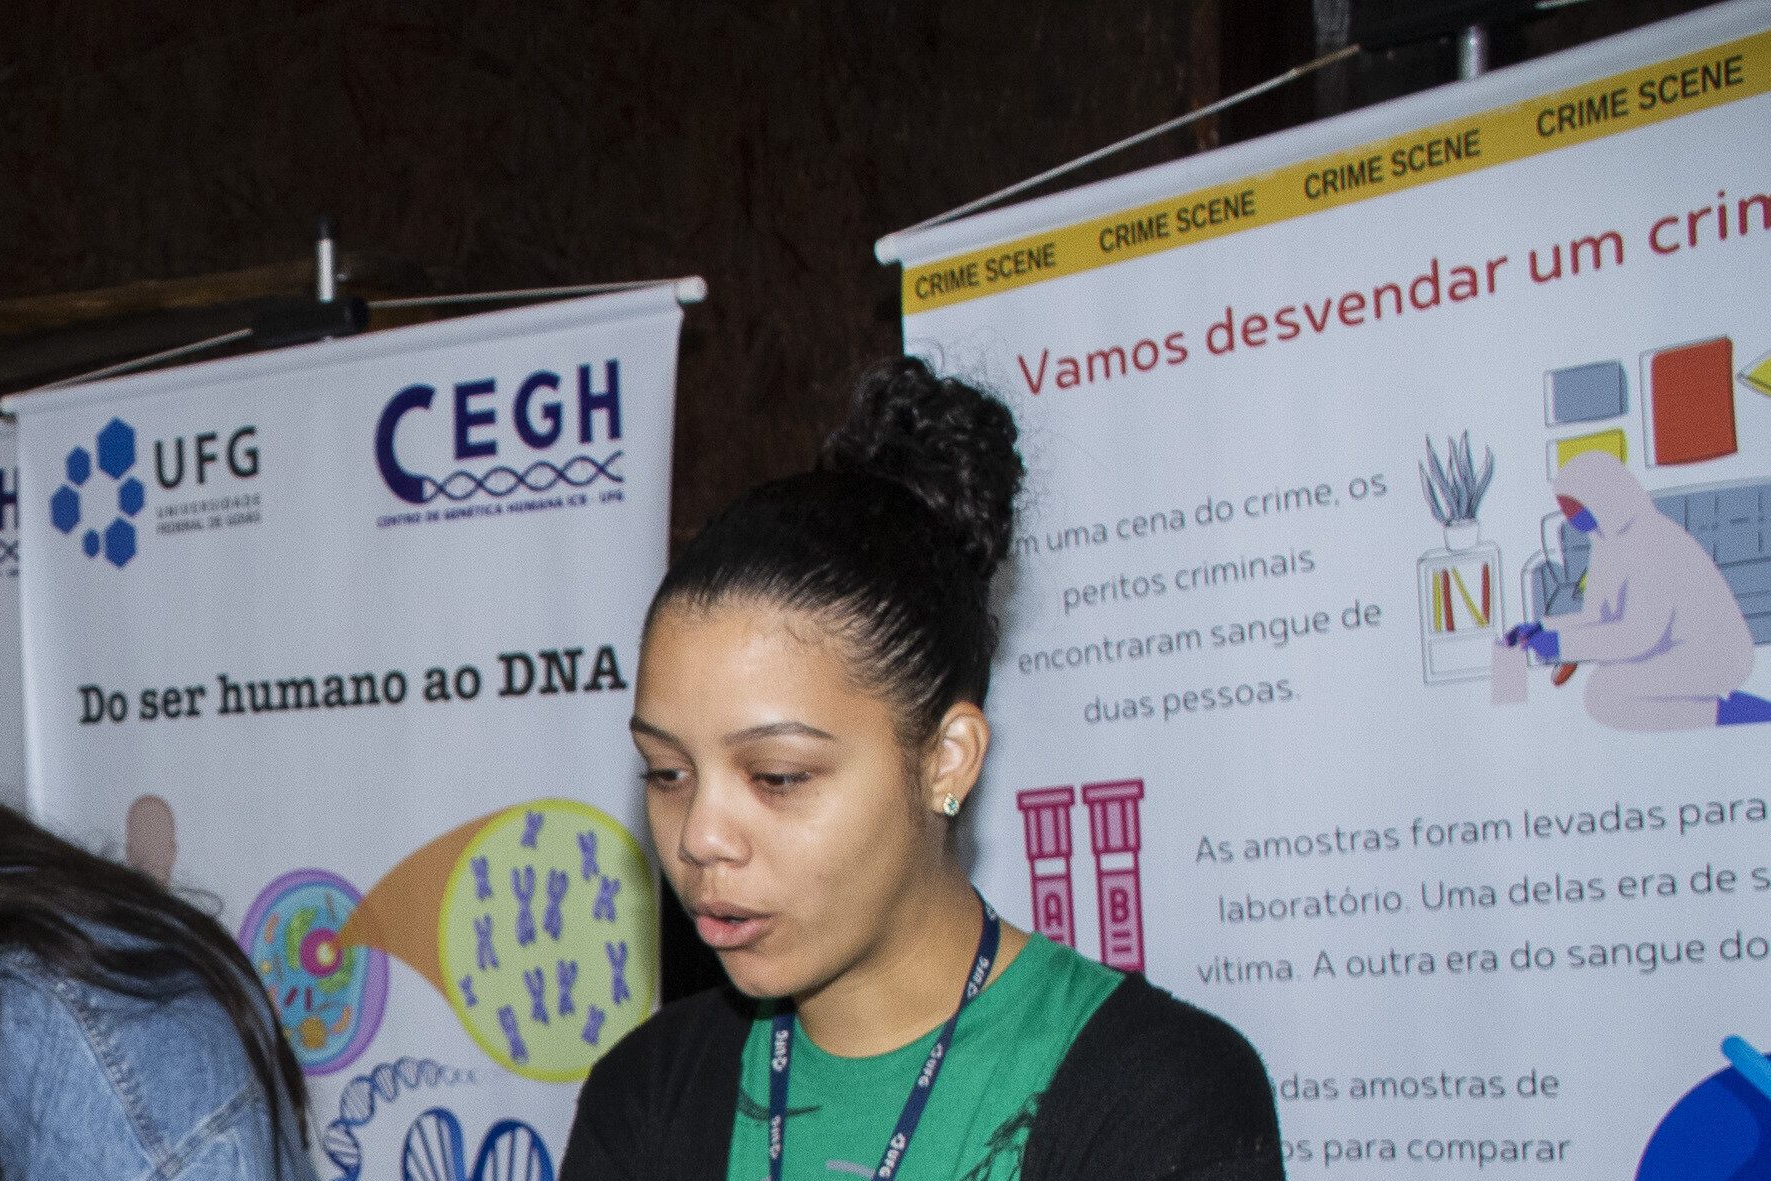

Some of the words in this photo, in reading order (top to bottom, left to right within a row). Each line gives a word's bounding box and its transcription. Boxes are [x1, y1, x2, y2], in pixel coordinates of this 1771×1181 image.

[915, 265, 980, 301] CRIME
[985, 242, 1056, 283] SCENE
[1099, 213, 1170, 253] CRIME
[1177, 190, 1256, 233] SCENE
[1304, 156, 1383, 199] CRIME
[1392, 129, 1482, 177] SCENE
[1536, 88, 1630, 138] CRIME
[1638, 55, 1745, 111] SCENE
[1018, 331, 1189, 395] Vamos
[1206, 256, 1509, 355] desvendar
[1529, 230, 1624, 284] um
[154, 424, 260, 491] UFG
[374, 357, 623, 508] CEGH
[1046, 521, 1108, 553] uma
[1116, 507, 1187, 541] cena
[1194, 495, 1234, 525] do
[1348, 472, 1388, 501] os
[1063, 570, 1167, 616] peritos
[1174, 546, 1316, 592] criminais
[1017, 625, 1202, 676] encontraram
[1210, 609, 1331, 649] sangue
[1341, 599, 1383, 631] de
[78, 684, 127, 725] Do
[139, 682, 207, 721] ser
[217, 668, 408, 715] humano
[423, 664, 482, 701] ao
[497, 644, 629, 698] DNA
[1083, 694, 1156, 726] duas
[1162, 677, 1302, 721] pessoas.
[1196, 834, 1234, 864] As
[1244, 825, 1400, 859] amostras
[1411, 816, 1512, 848] foram
[1524, 802, 1666, 840] levadas
[1679, 797, 1769, 837] para
[1043, 891, 1063, 928] A
[1109, 887, 1129, 924] B
[1421, 880, 1497, 911] Uma
[1508, 873, 1606, 905] delas
[1618, 873, 1679, 900] era
[1690, 862, 1738, 895] de
[1313, 948, 1337, 978] A
[1345, 947, 1436, 978] outra
[1446, 949, 1499, 974] era
[1510, 940, 1556, 971] do
[1568, 939, 1706, 975] sangue
[1719, 929, 1770, 963] do
[1349, 1070, 1506, 1101] amostras
[1517, 1066, 1561, 1099] de
[1324, 1137, 1397, 1168] para
[1407, 1138, 1572, 1171] comparar
